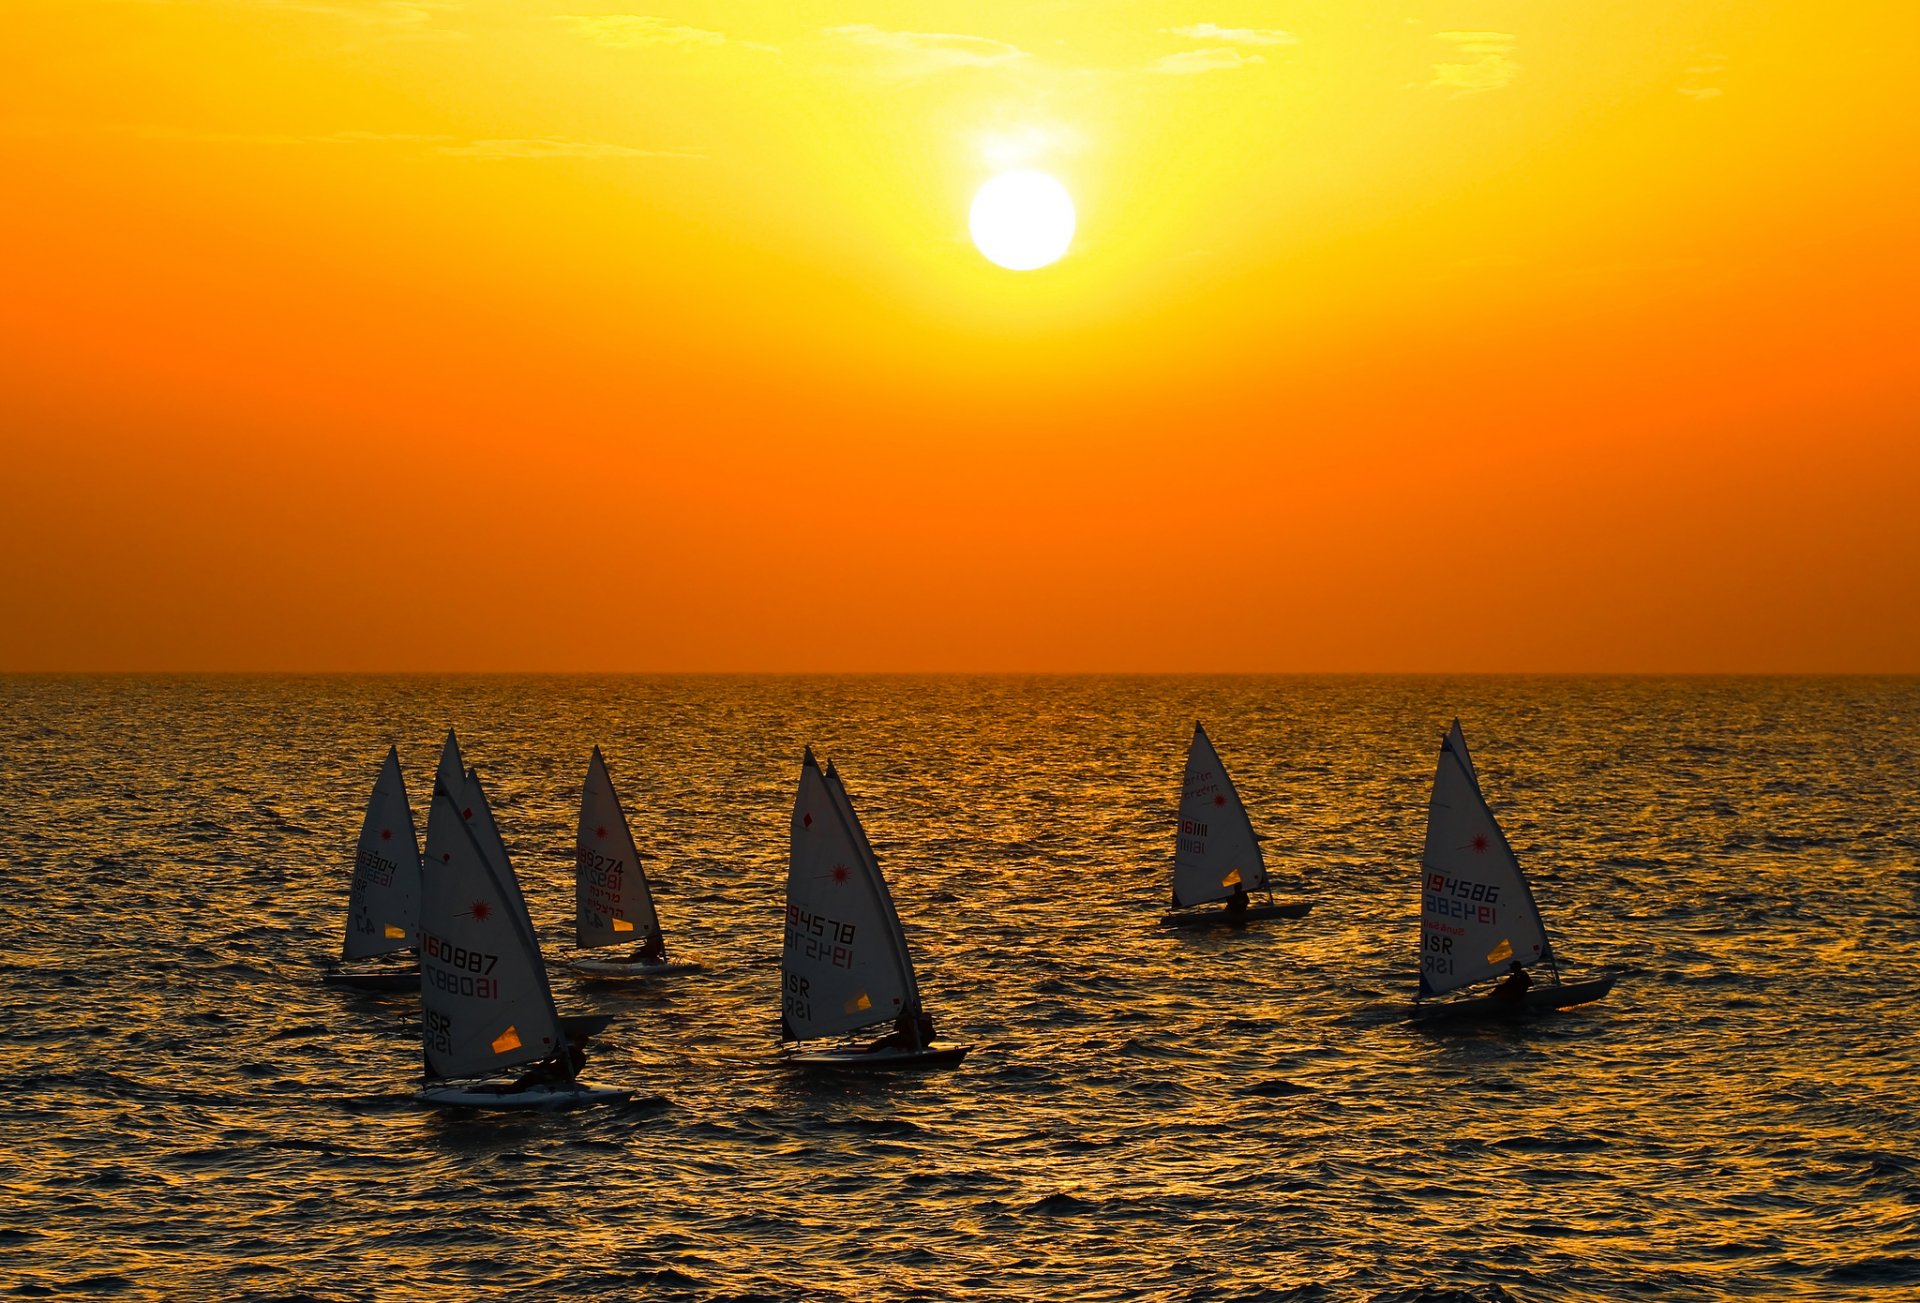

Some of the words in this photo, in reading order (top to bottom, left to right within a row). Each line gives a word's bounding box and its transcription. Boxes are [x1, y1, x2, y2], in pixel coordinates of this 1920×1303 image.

[1181, 819, 1207, 837] 161111
[358, 850, 397, 875] 163304
[577, 846, 624, 876] 189274
[354, 878, 368, 893] ISR
[1426, 873, 1501, 904] 194586
[423, 933, 498, 975] 160887
[1424, 934, 1453, 955] ISR
[784, 970, 810, 999] ISR
[426, 1008, 451, 1036] ISR
